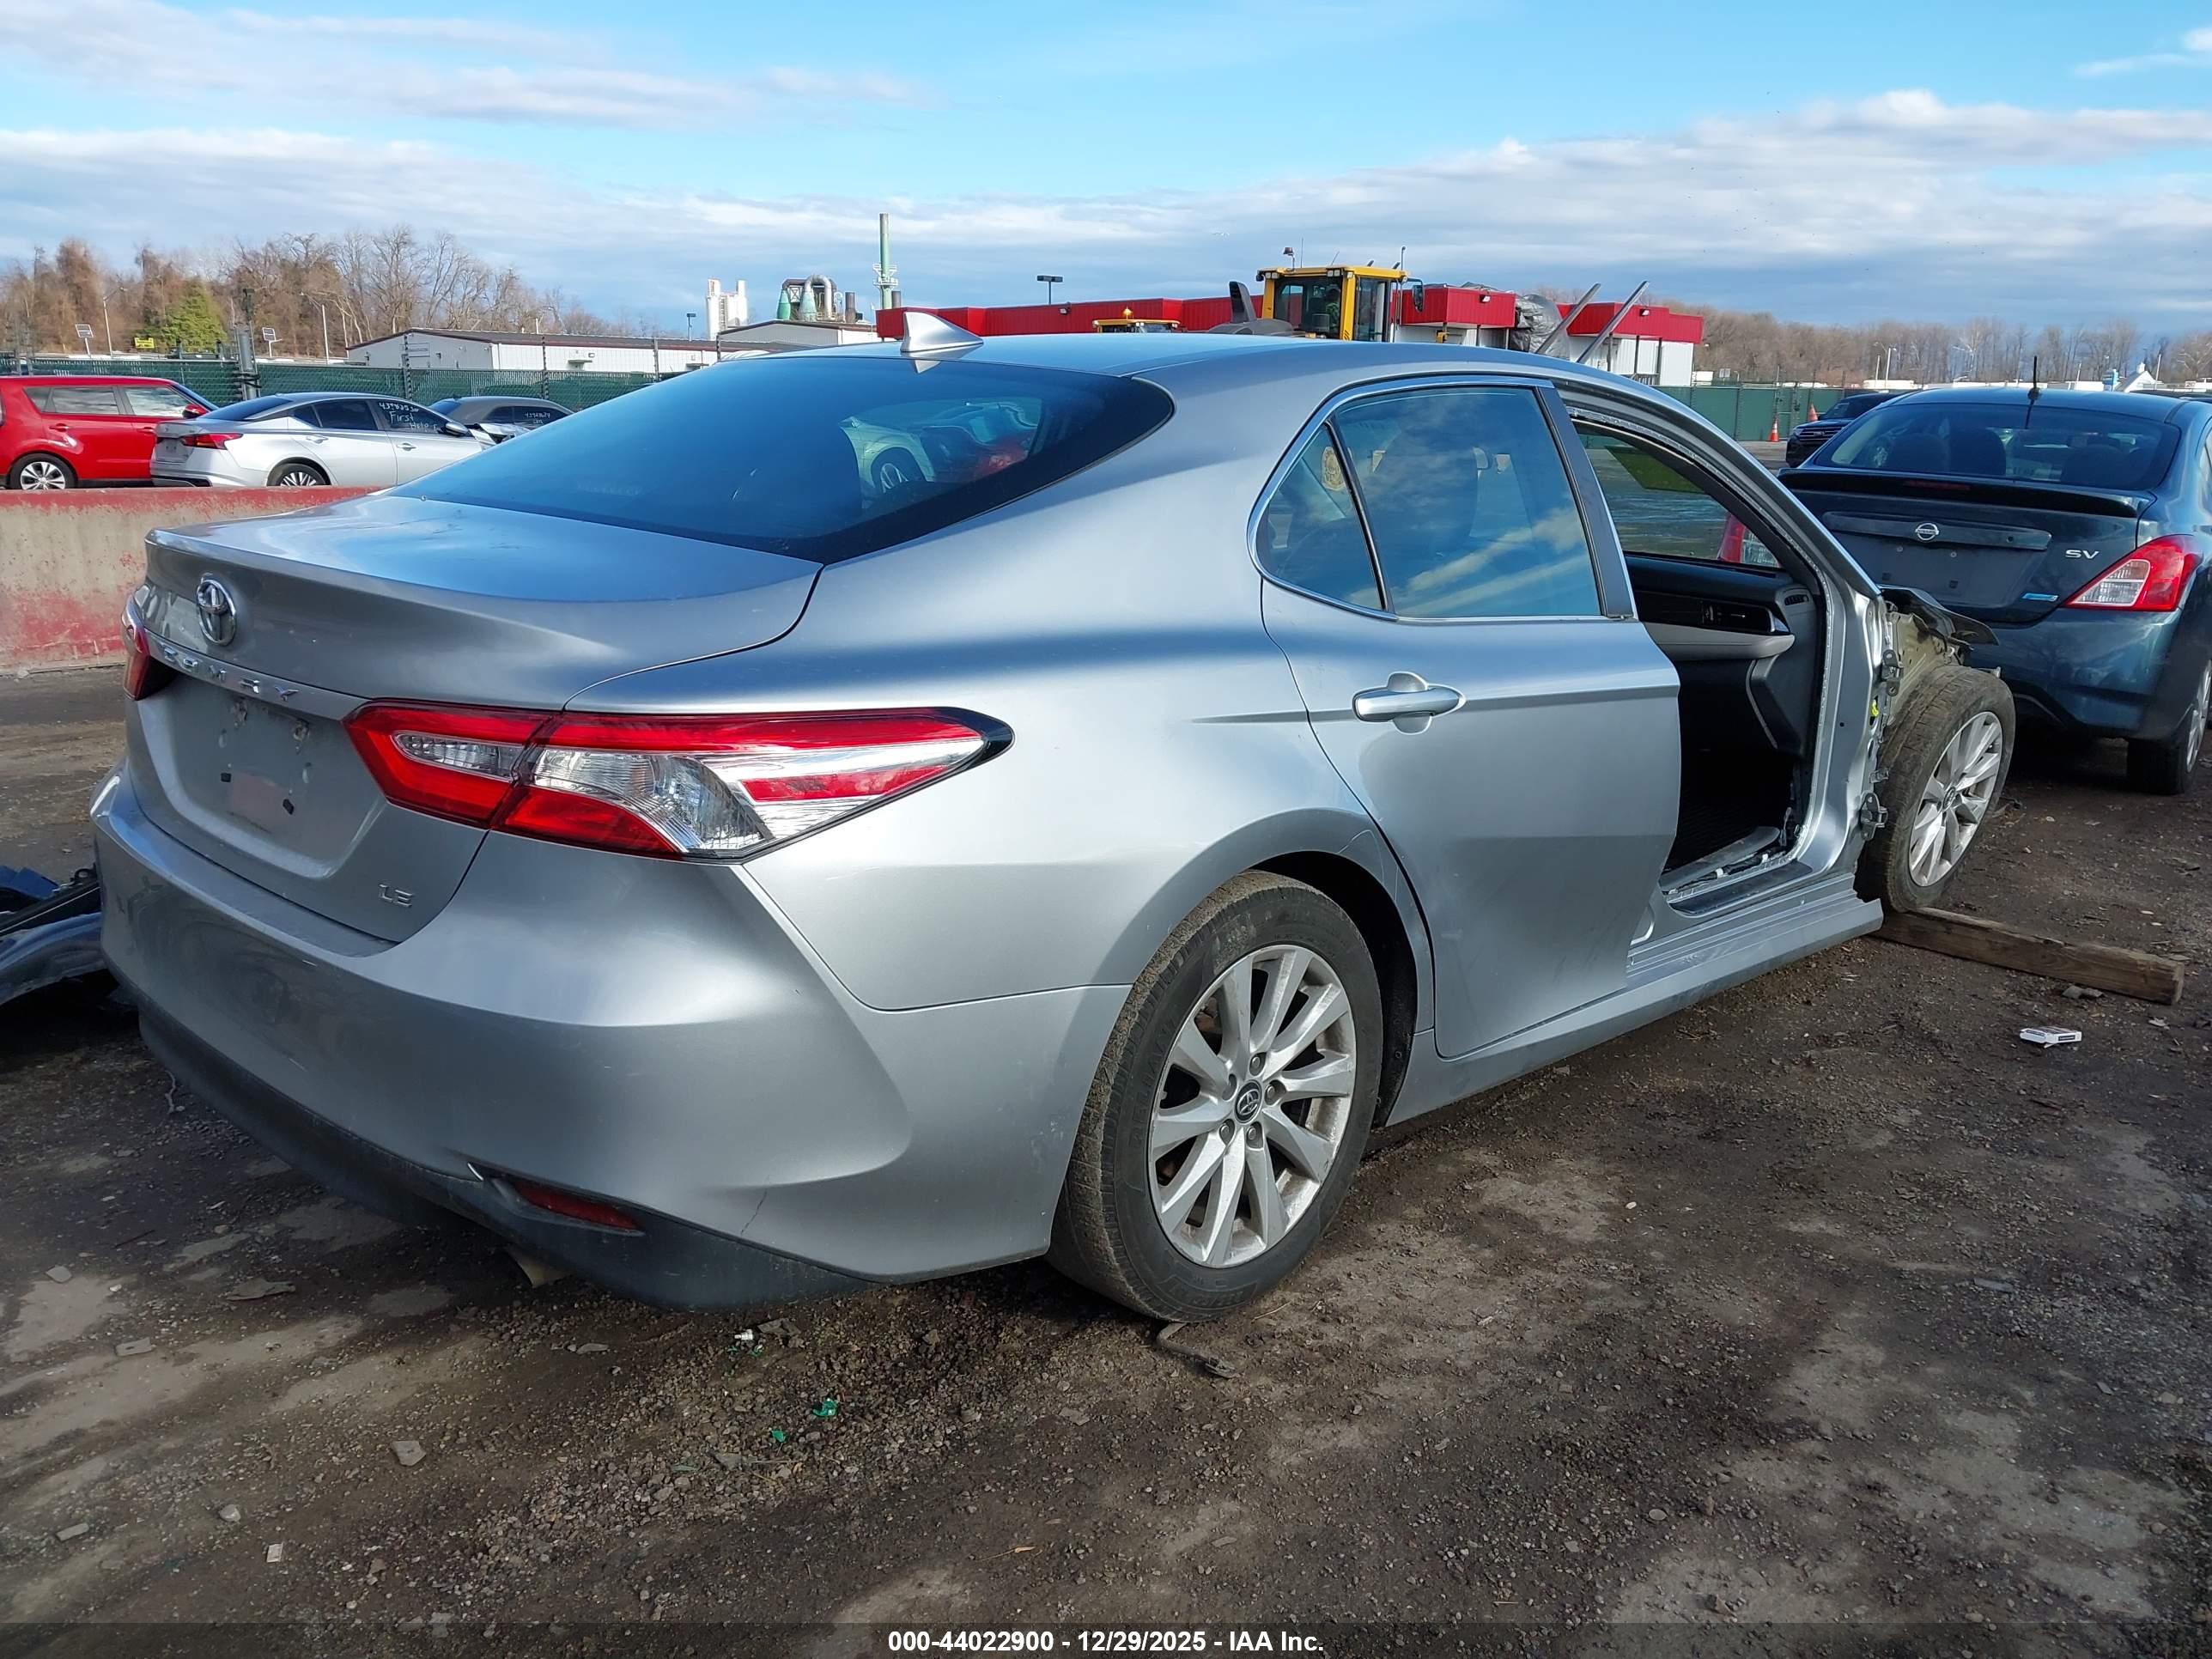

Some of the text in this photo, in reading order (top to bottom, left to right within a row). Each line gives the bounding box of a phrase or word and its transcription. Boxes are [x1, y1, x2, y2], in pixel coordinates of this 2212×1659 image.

[389, 410, 414, 424] First
[2065, 550, 2100, 559] SV
[379, 884, 413, 907] LE
